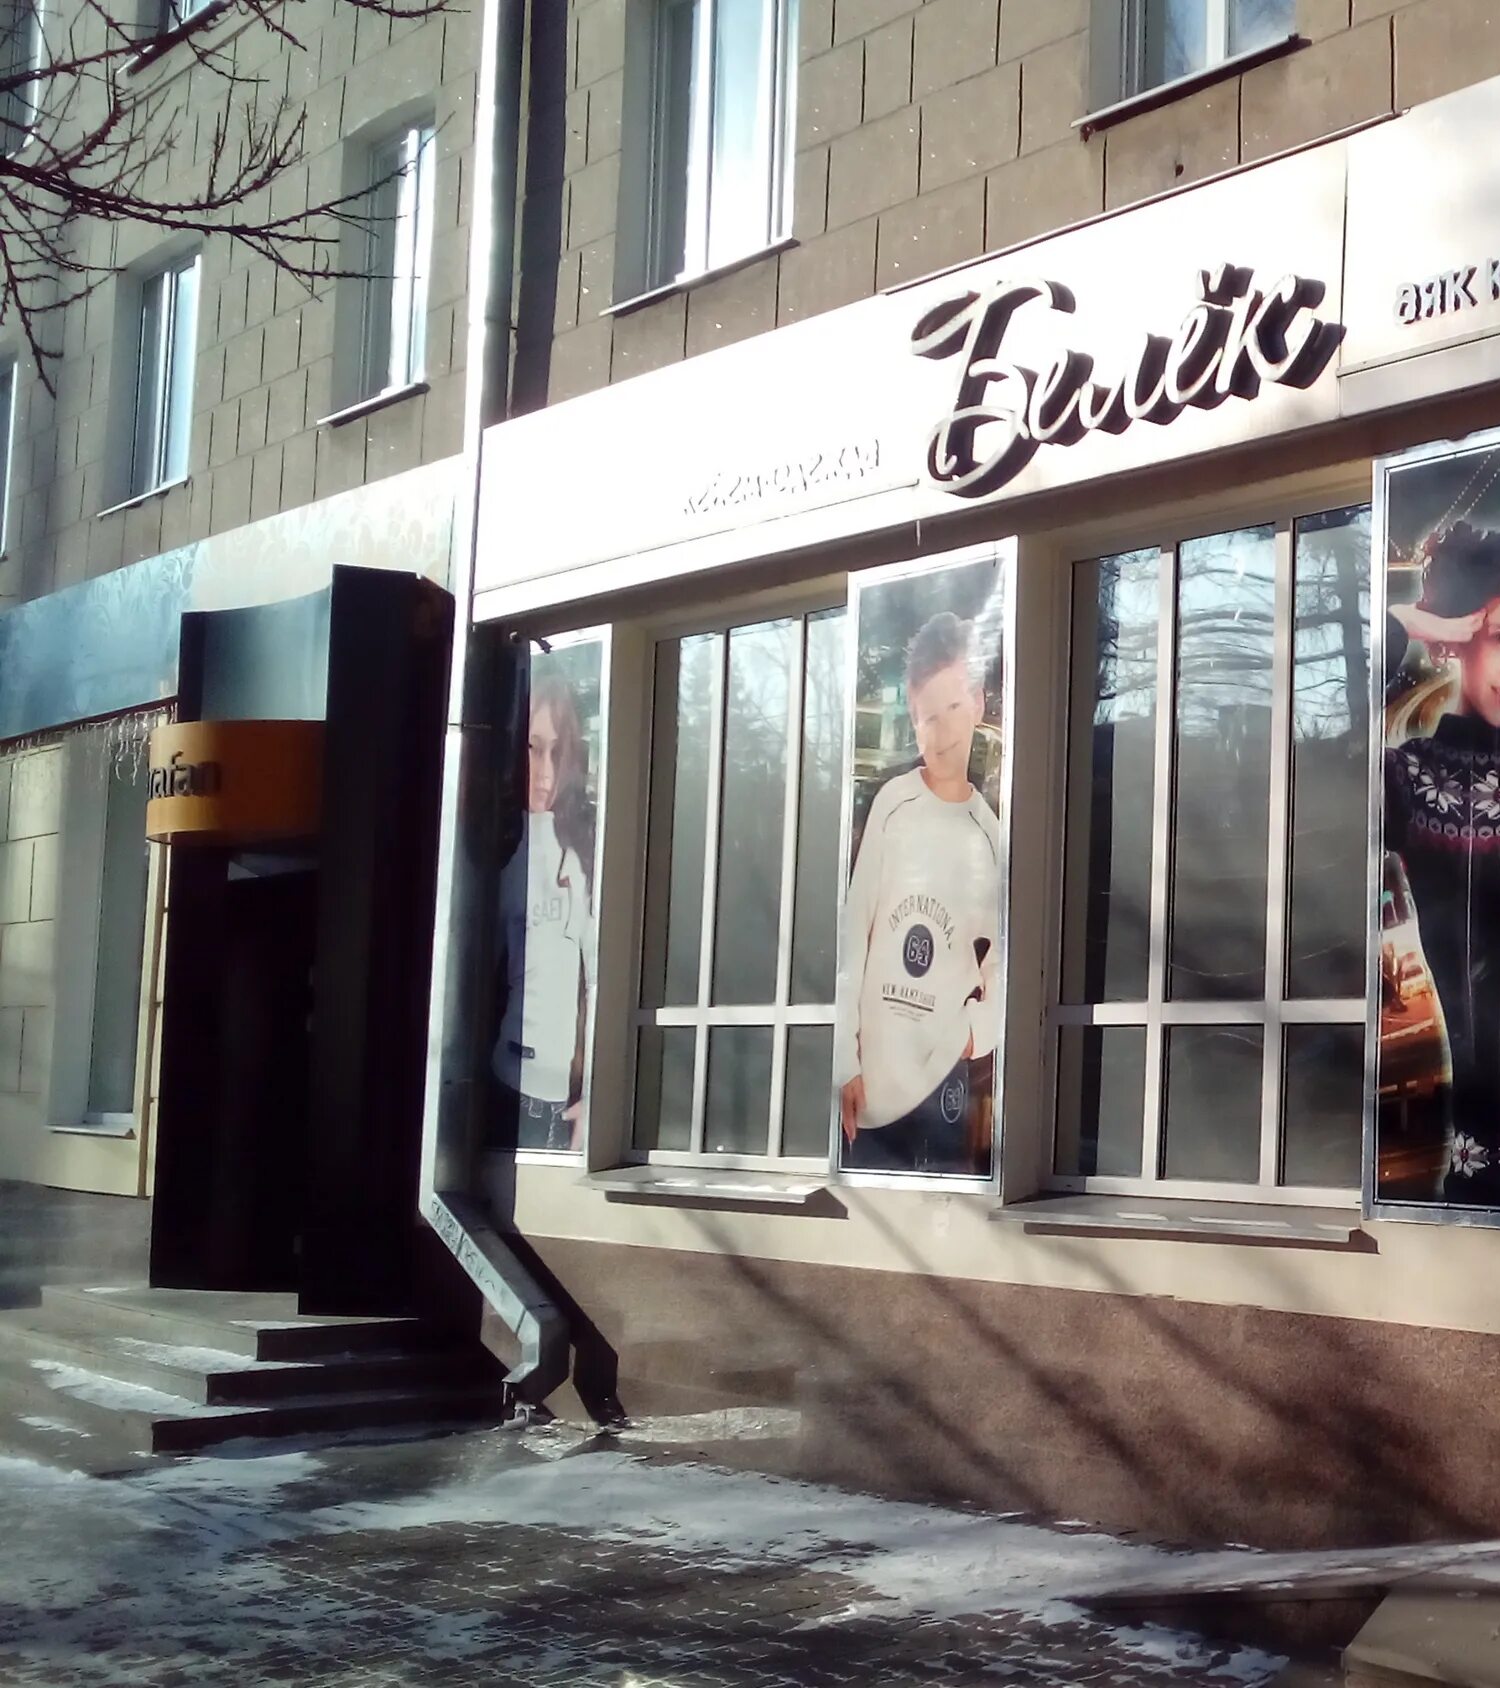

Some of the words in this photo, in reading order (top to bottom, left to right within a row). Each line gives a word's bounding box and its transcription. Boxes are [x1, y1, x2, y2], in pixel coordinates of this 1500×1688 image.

[1393, 266, 1478, 326] аяк
[911, 261, 1348, 499] Белёк
[147, 750, 222, 800] rafan
[887, 893, 954, 950] INTERNATIONA
